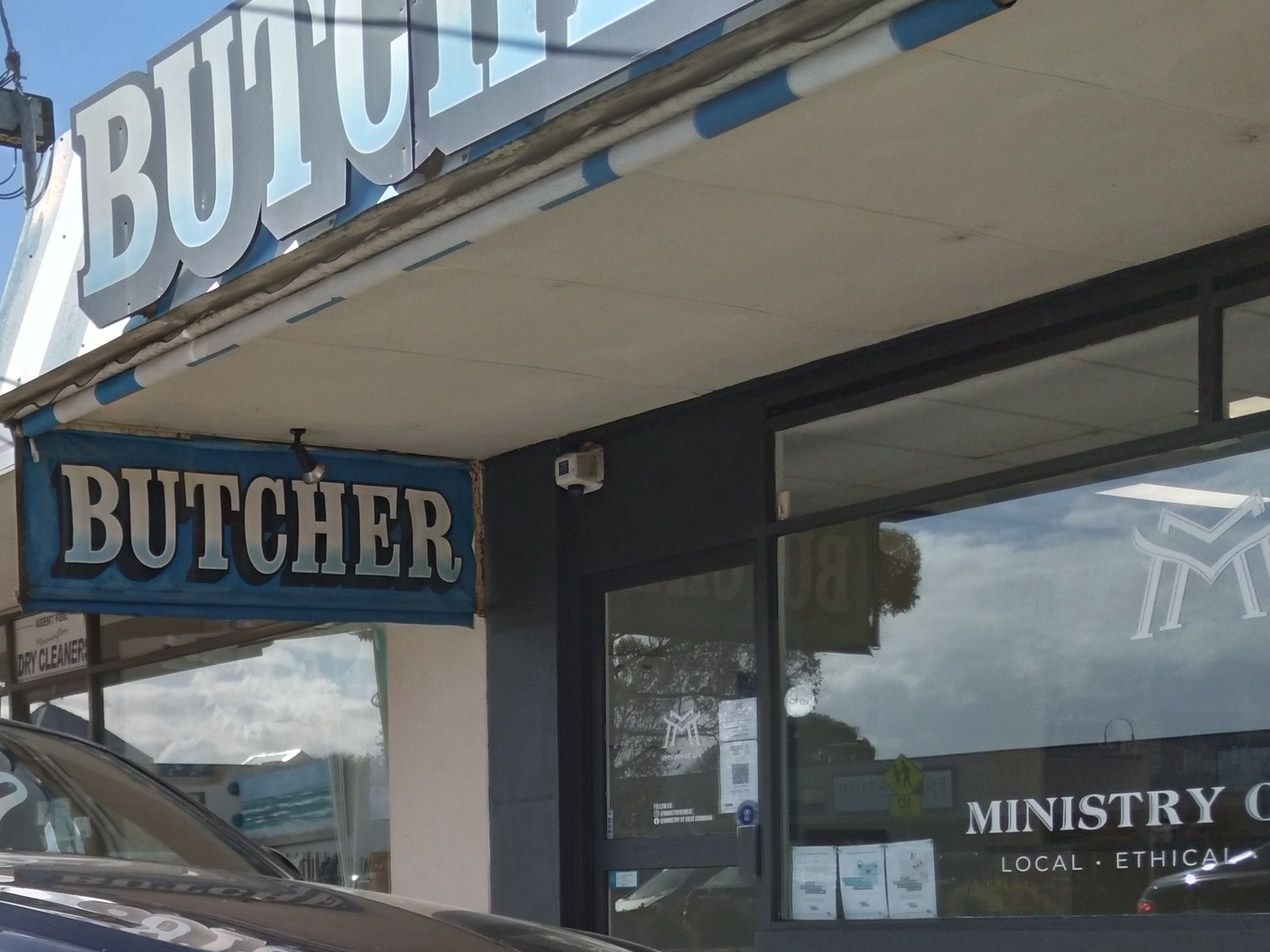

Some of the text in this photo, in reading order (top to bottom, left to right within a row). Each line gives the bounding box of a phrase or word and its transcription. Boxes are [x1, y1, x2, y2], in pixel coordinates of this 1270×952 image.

[75, 0, 656, 298] BUTC
[60, 463, 464, 584] BUTCHER
[18, 650, 37, 677] DRY
[965, 786, 1226, 835] MINISTRY
[1001, 847, 1236, 873] LOCAL ETHICAL
